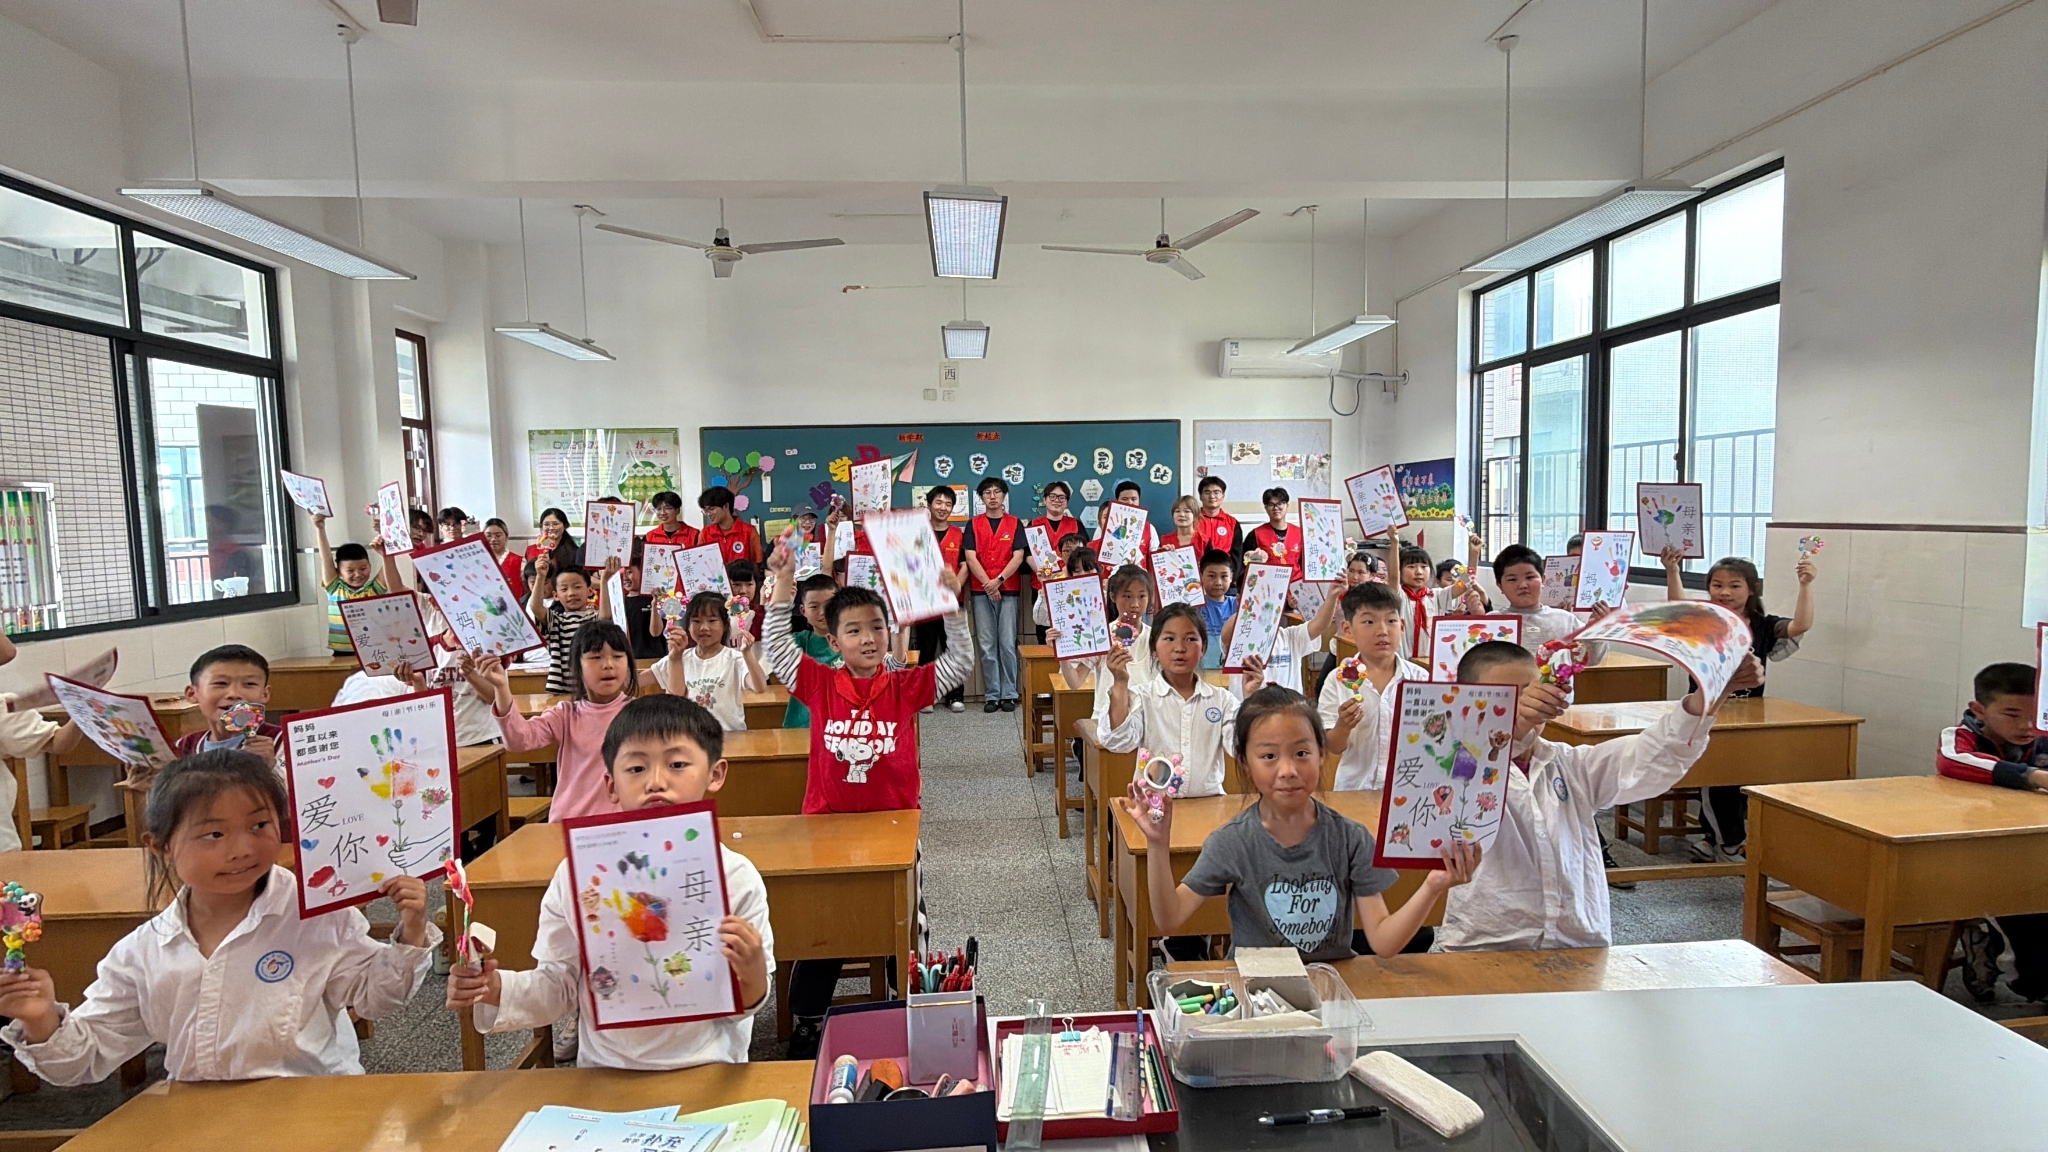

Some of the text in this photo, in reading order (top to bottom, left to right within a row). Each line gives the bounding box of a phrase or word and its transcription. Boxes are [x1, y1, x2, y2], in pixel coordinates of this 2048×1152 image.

[943, 367, 957, 381] 西
[1681, 505, 1698, 536] 母亲
[619, 522, 632, 549] 母亲
[644, 545, 658, 577] 母亲节
[682, 551, 696, 591] 母亲节
[1307, 543, 1320, 576] 妈妈
[1052, 583, 1068, 631] 母亲节
[1405, 698, 1436, 707] 一直以来
[1406, 687, 1422, 696] 妈妈
[293, 722, 316, 734] 妈妈
[294, 730, 339, 744] 一直以来
[296, 741, 340, 758] 都感谢您
[327, 753, 341, 763] Day
[1395, 756, 1423, 789] 爱
[301, 793, 340, 834] 爱
[342, 812, 365, 826] LOVE
[1408, 796, 1437, 828] 你
[329, 832, 369, 868] 你
[1270, 872, 1334, 895] Looking
[678, 869, 715, 953] 母亲
[1287, 894, 1321, 915] For
[640, 1133, 686, 1149] 补充
